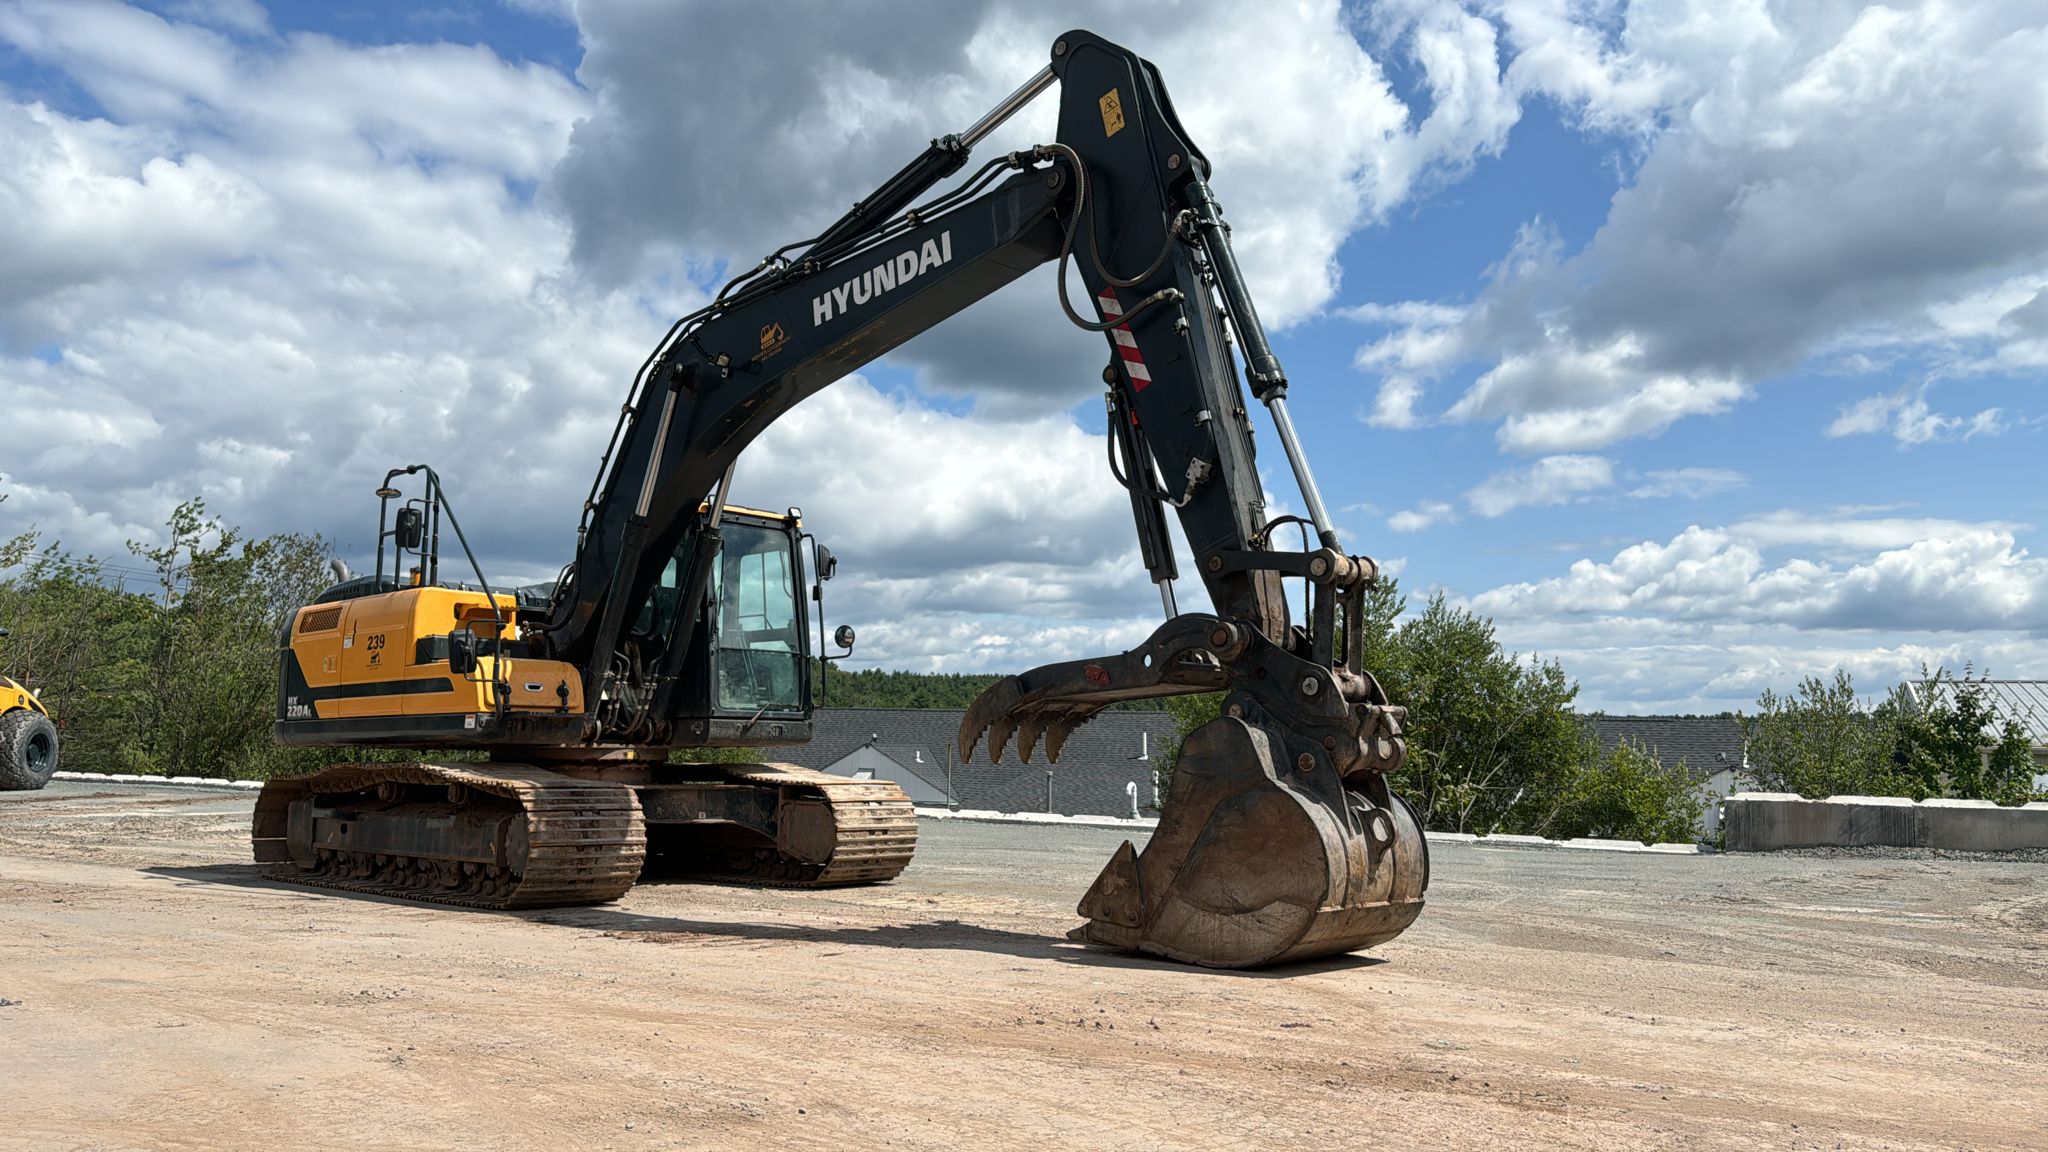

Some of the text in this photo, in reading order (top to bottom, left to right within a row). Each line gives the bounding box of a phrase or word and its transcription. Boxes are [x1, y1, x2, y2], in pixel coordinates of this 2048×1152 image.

[812, 230, 952, 327] HYUNDAI
[367, 634, 385, 650] 239
[287, 696, 298, 705] HX
